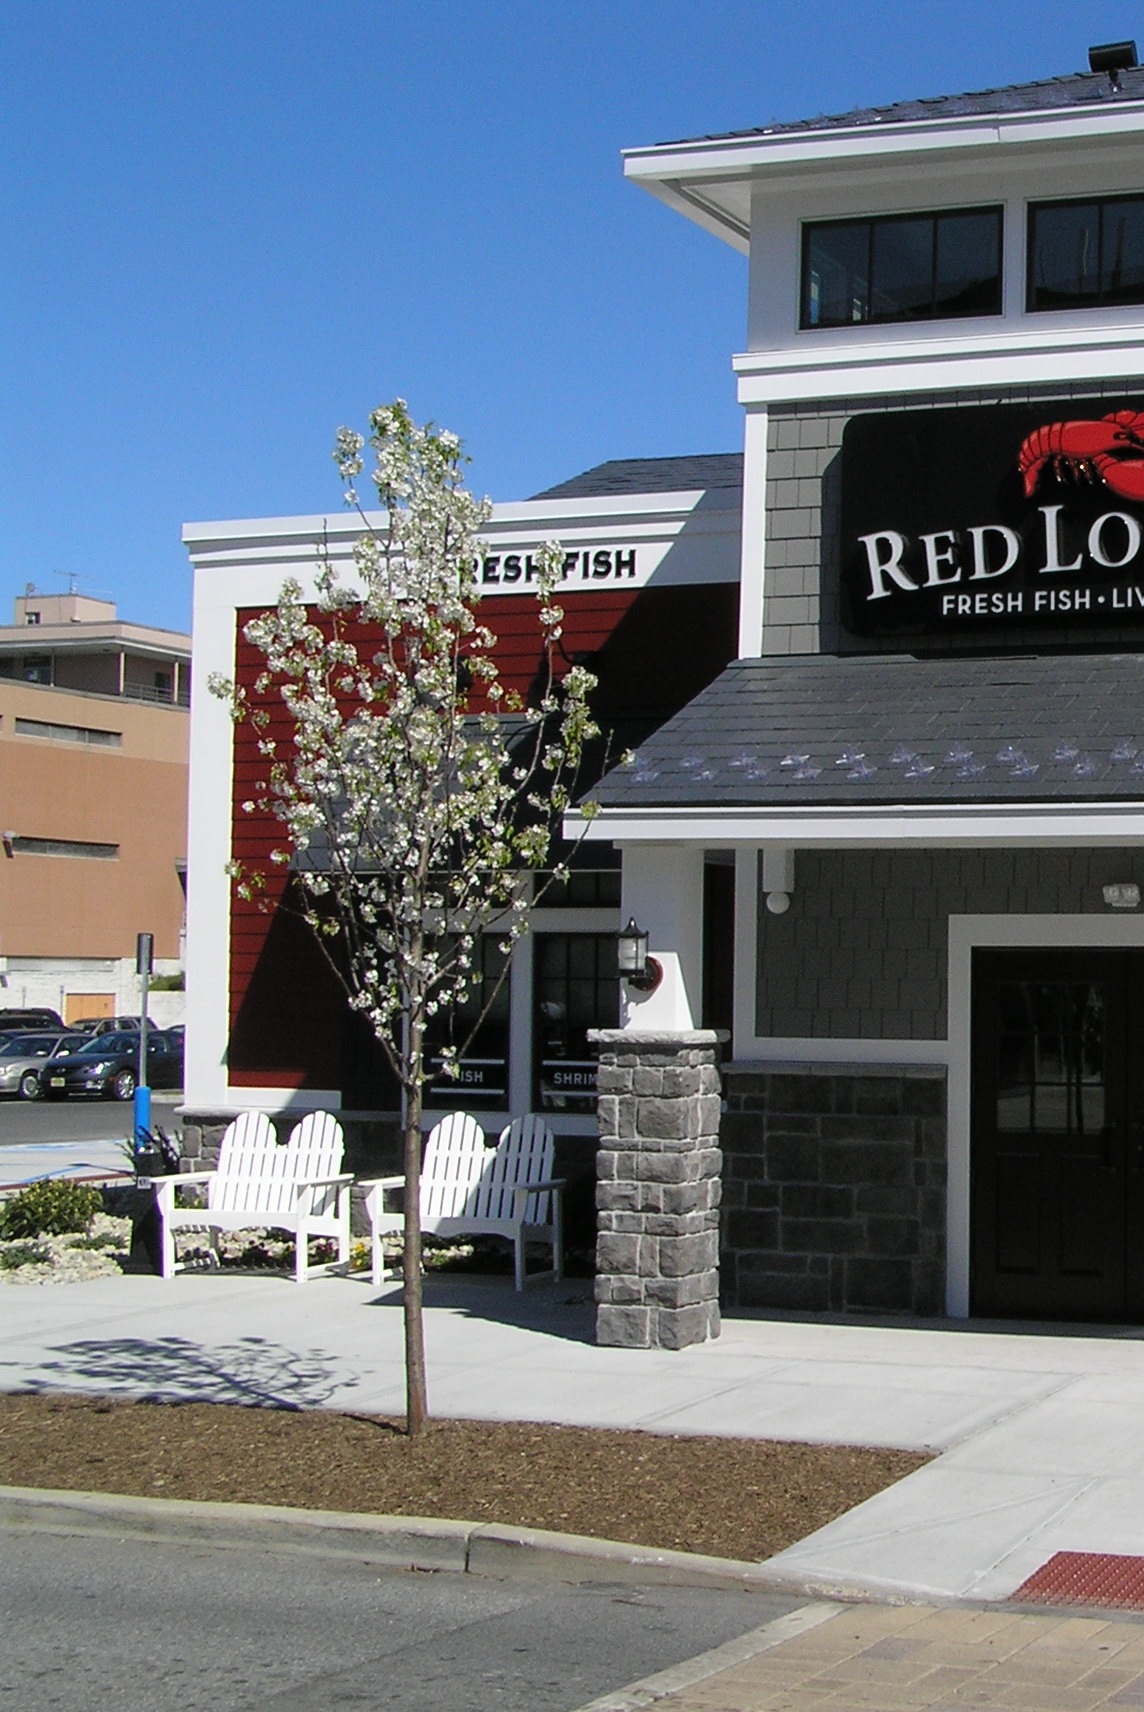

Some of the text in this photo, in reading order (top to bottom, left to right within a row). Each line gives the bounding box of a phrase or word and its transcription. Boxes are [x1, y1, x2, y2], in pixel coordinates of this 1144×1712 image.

[561, 550, 637, 581] FISH
[857, 524, 1021, 600] RED
[942, 592, 1024, 617] FRESH
[1033, 588, 1092, 612] FISH
[451, 1070, 484, 1082] ISH
[553, 1072, 598, 1085] SHRIM
